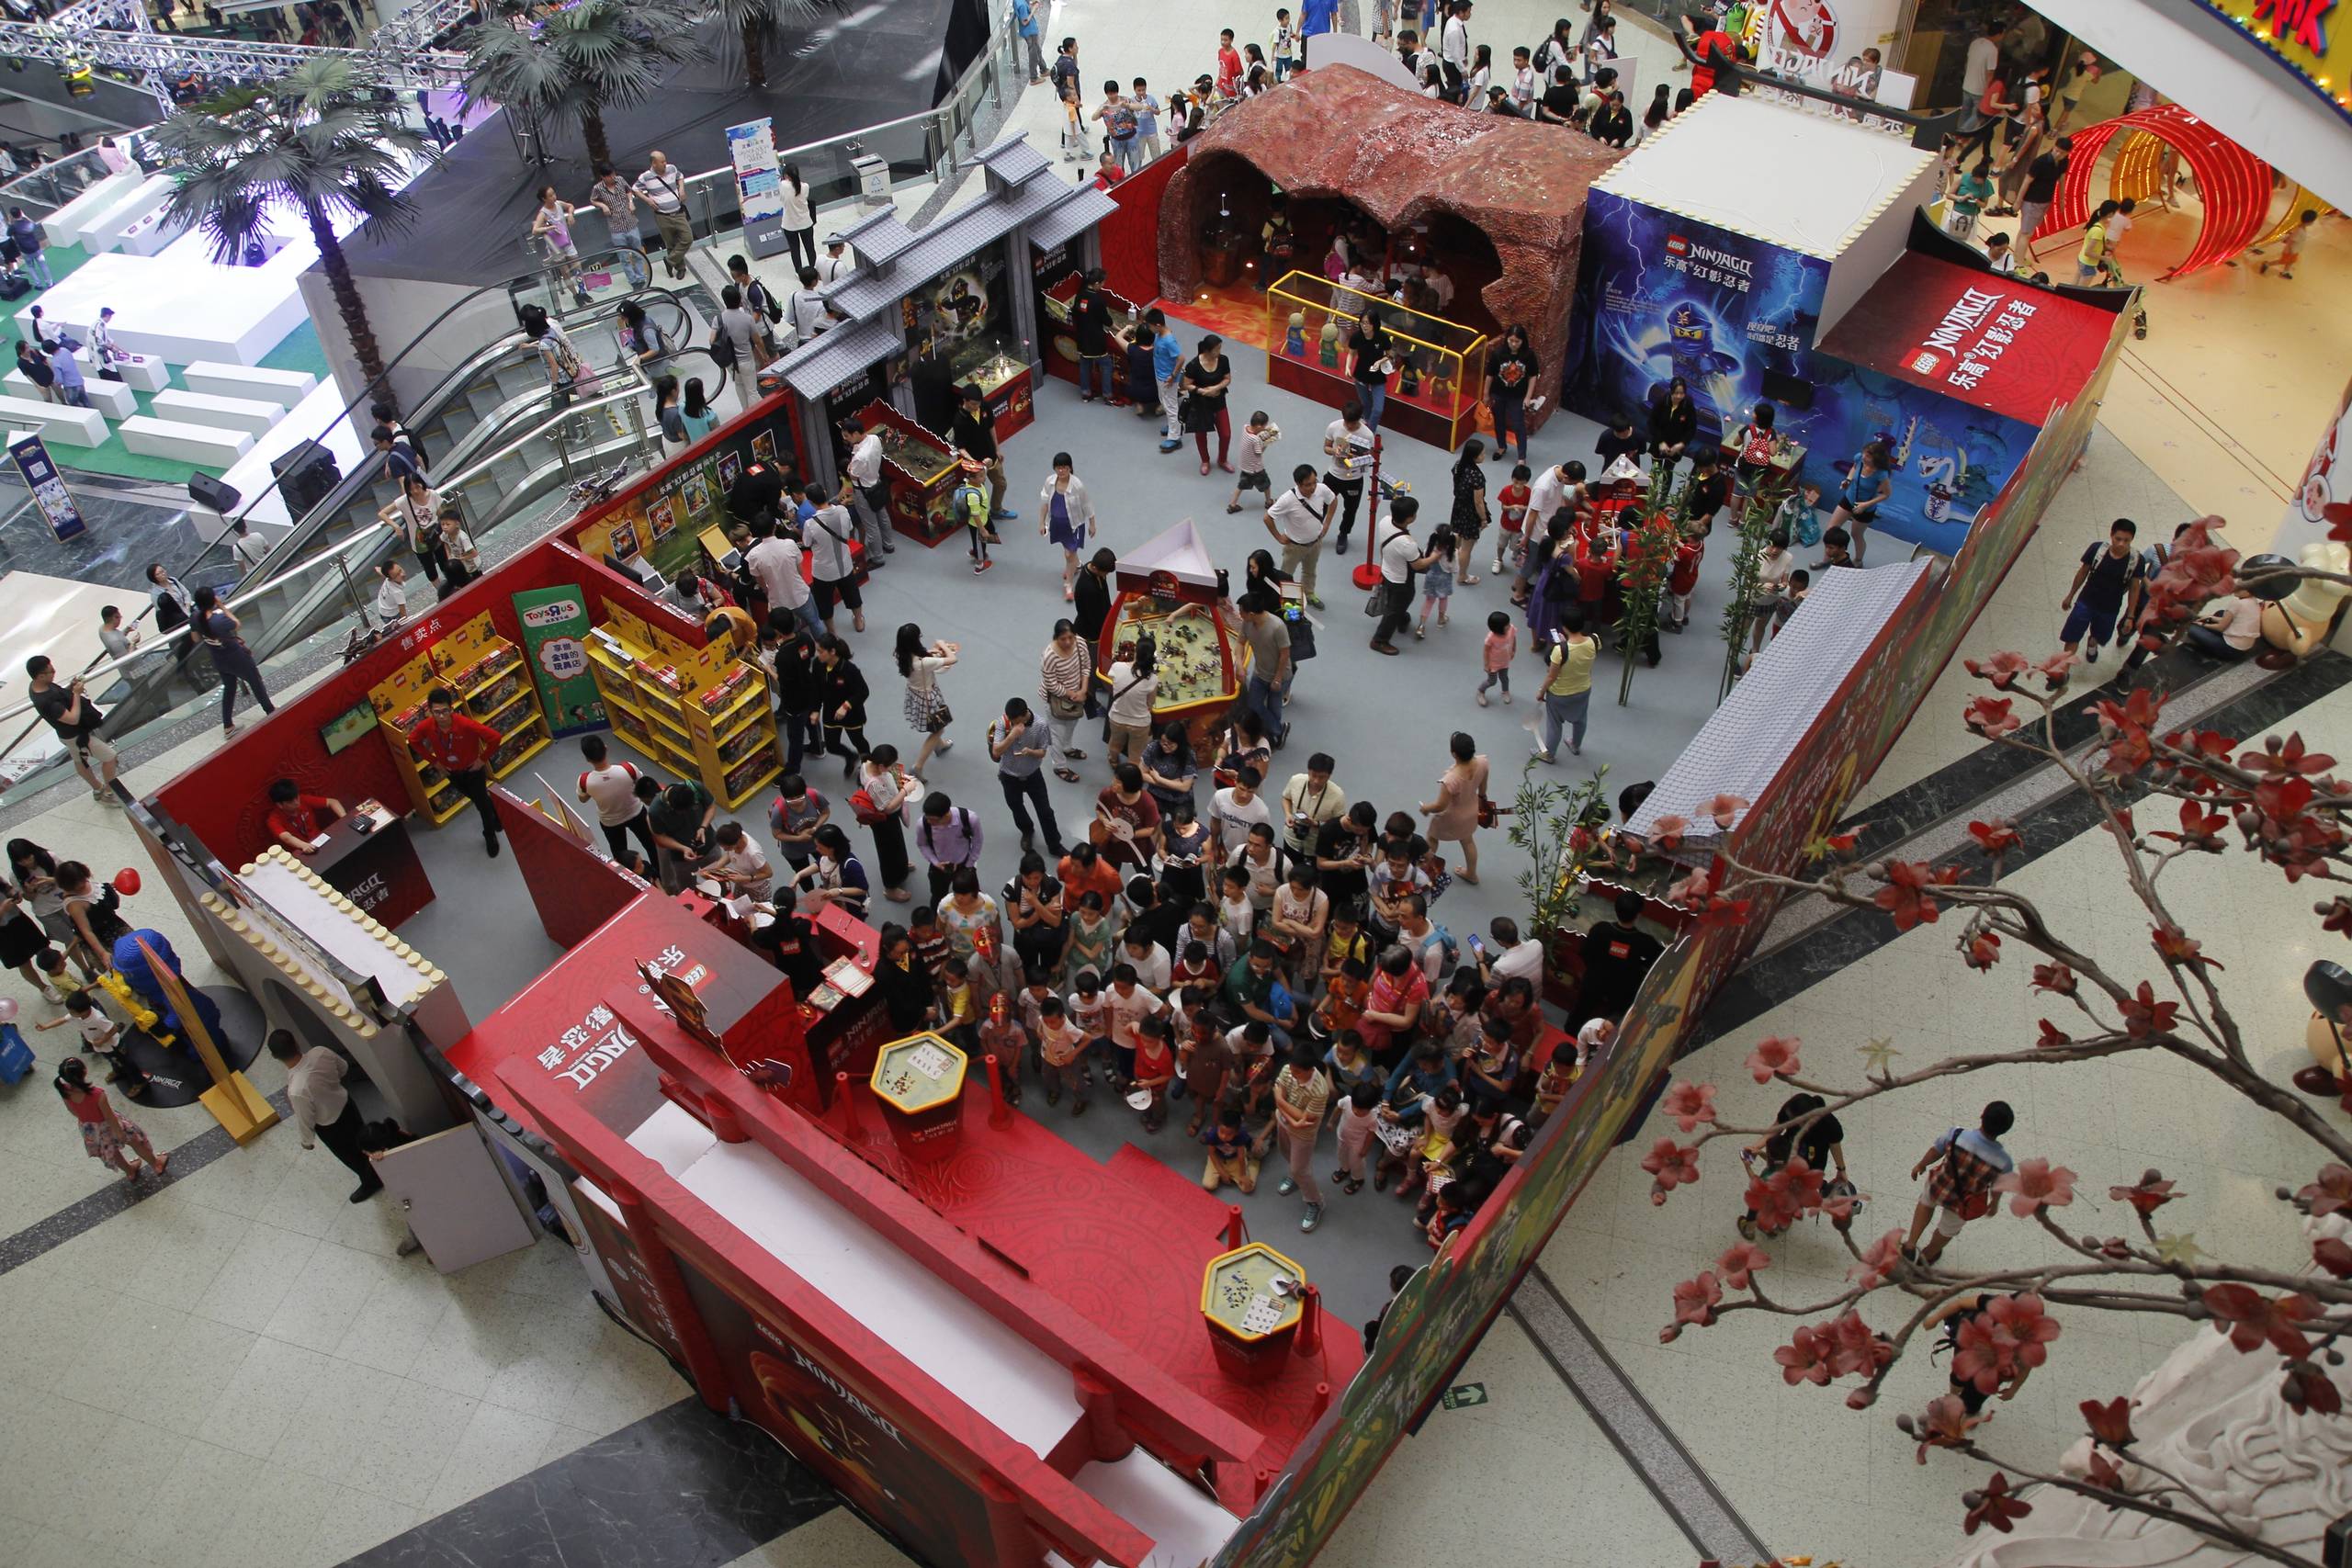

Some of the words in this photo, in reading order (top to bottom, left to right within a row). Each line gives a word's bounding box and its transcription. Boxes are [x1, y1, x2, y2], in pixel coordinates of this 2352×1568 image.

[1689, 243, 1753, 278] NINJAGO
[1921, 287, 2006, 358] NINJAGO
[1912, 352, 1939, 375] LEGO
[401, 618, 442, 651] 售卖点
[552, 650, 579, 661] 全球的
[553, 660, 581, 671] 玩具店
